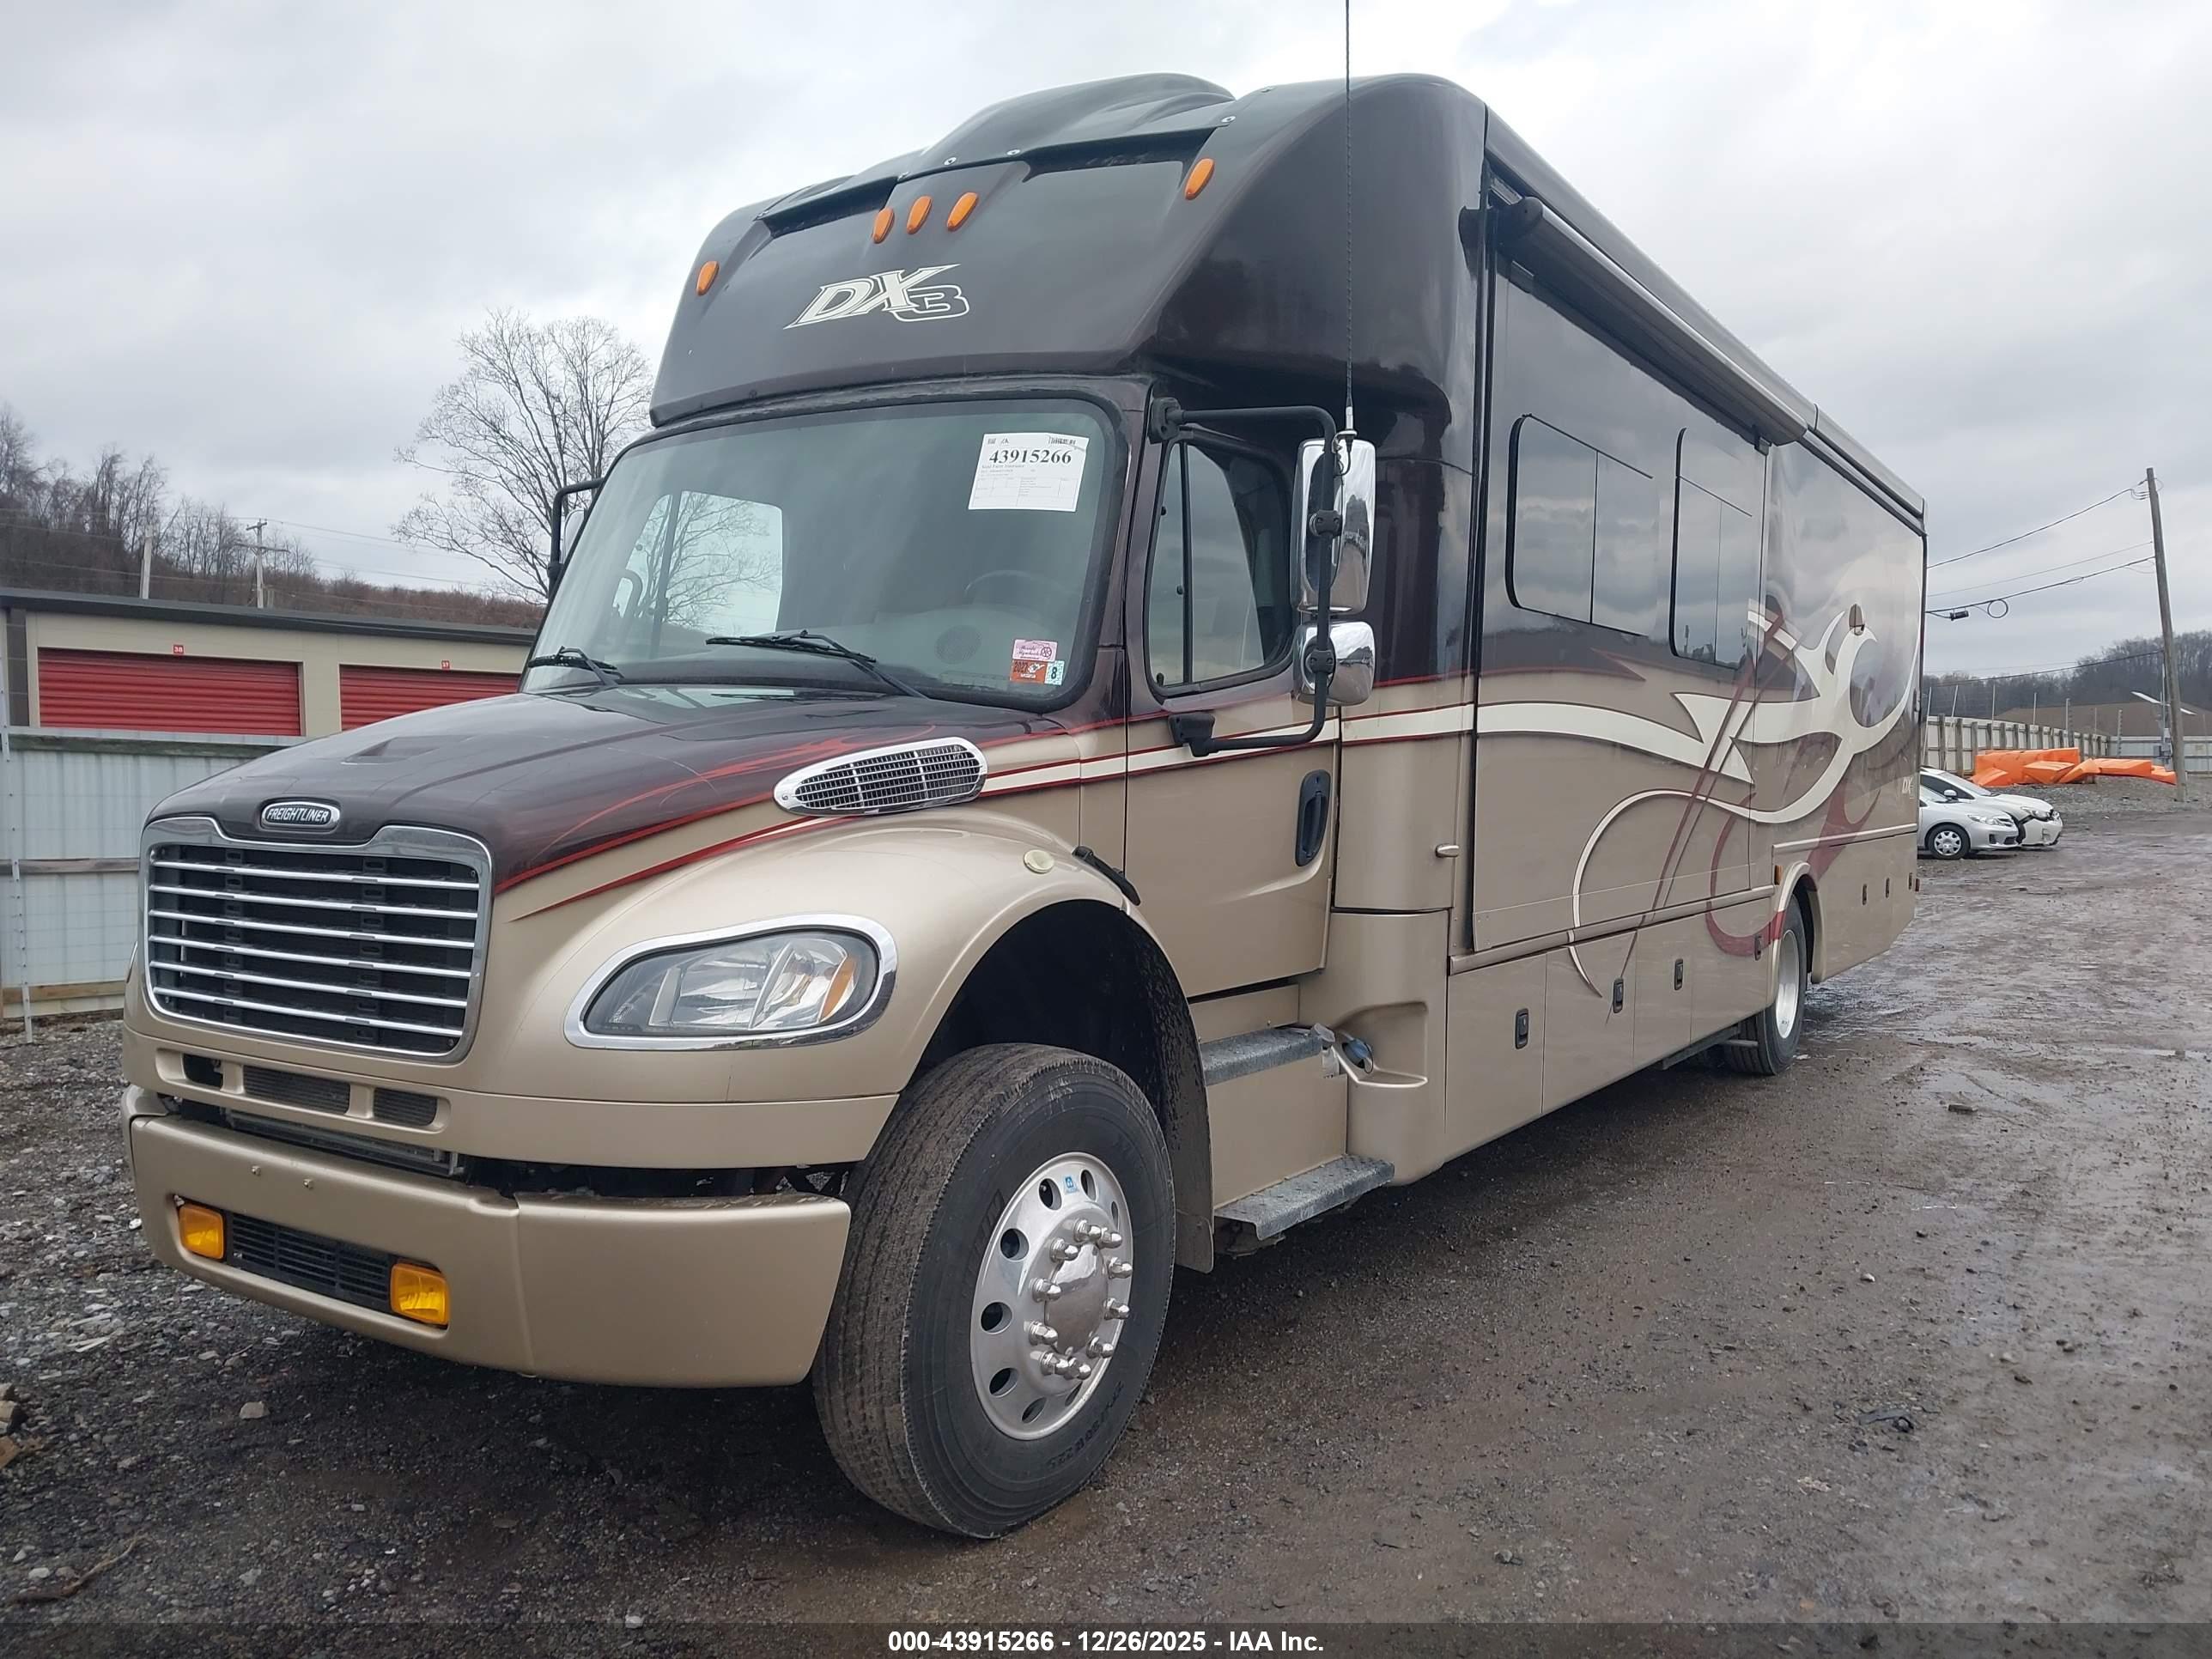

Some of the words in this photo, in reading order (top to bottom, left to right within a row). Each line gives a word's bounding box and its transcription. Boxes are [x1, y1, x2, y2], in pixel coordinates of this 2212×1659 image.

[782, 264, 969, 330] DX3
[989, 449, 1072, 464] 43915266
[1051, 666, 1058, 679] 8
[266, 807, 329, 822] FREIGHTLINER
